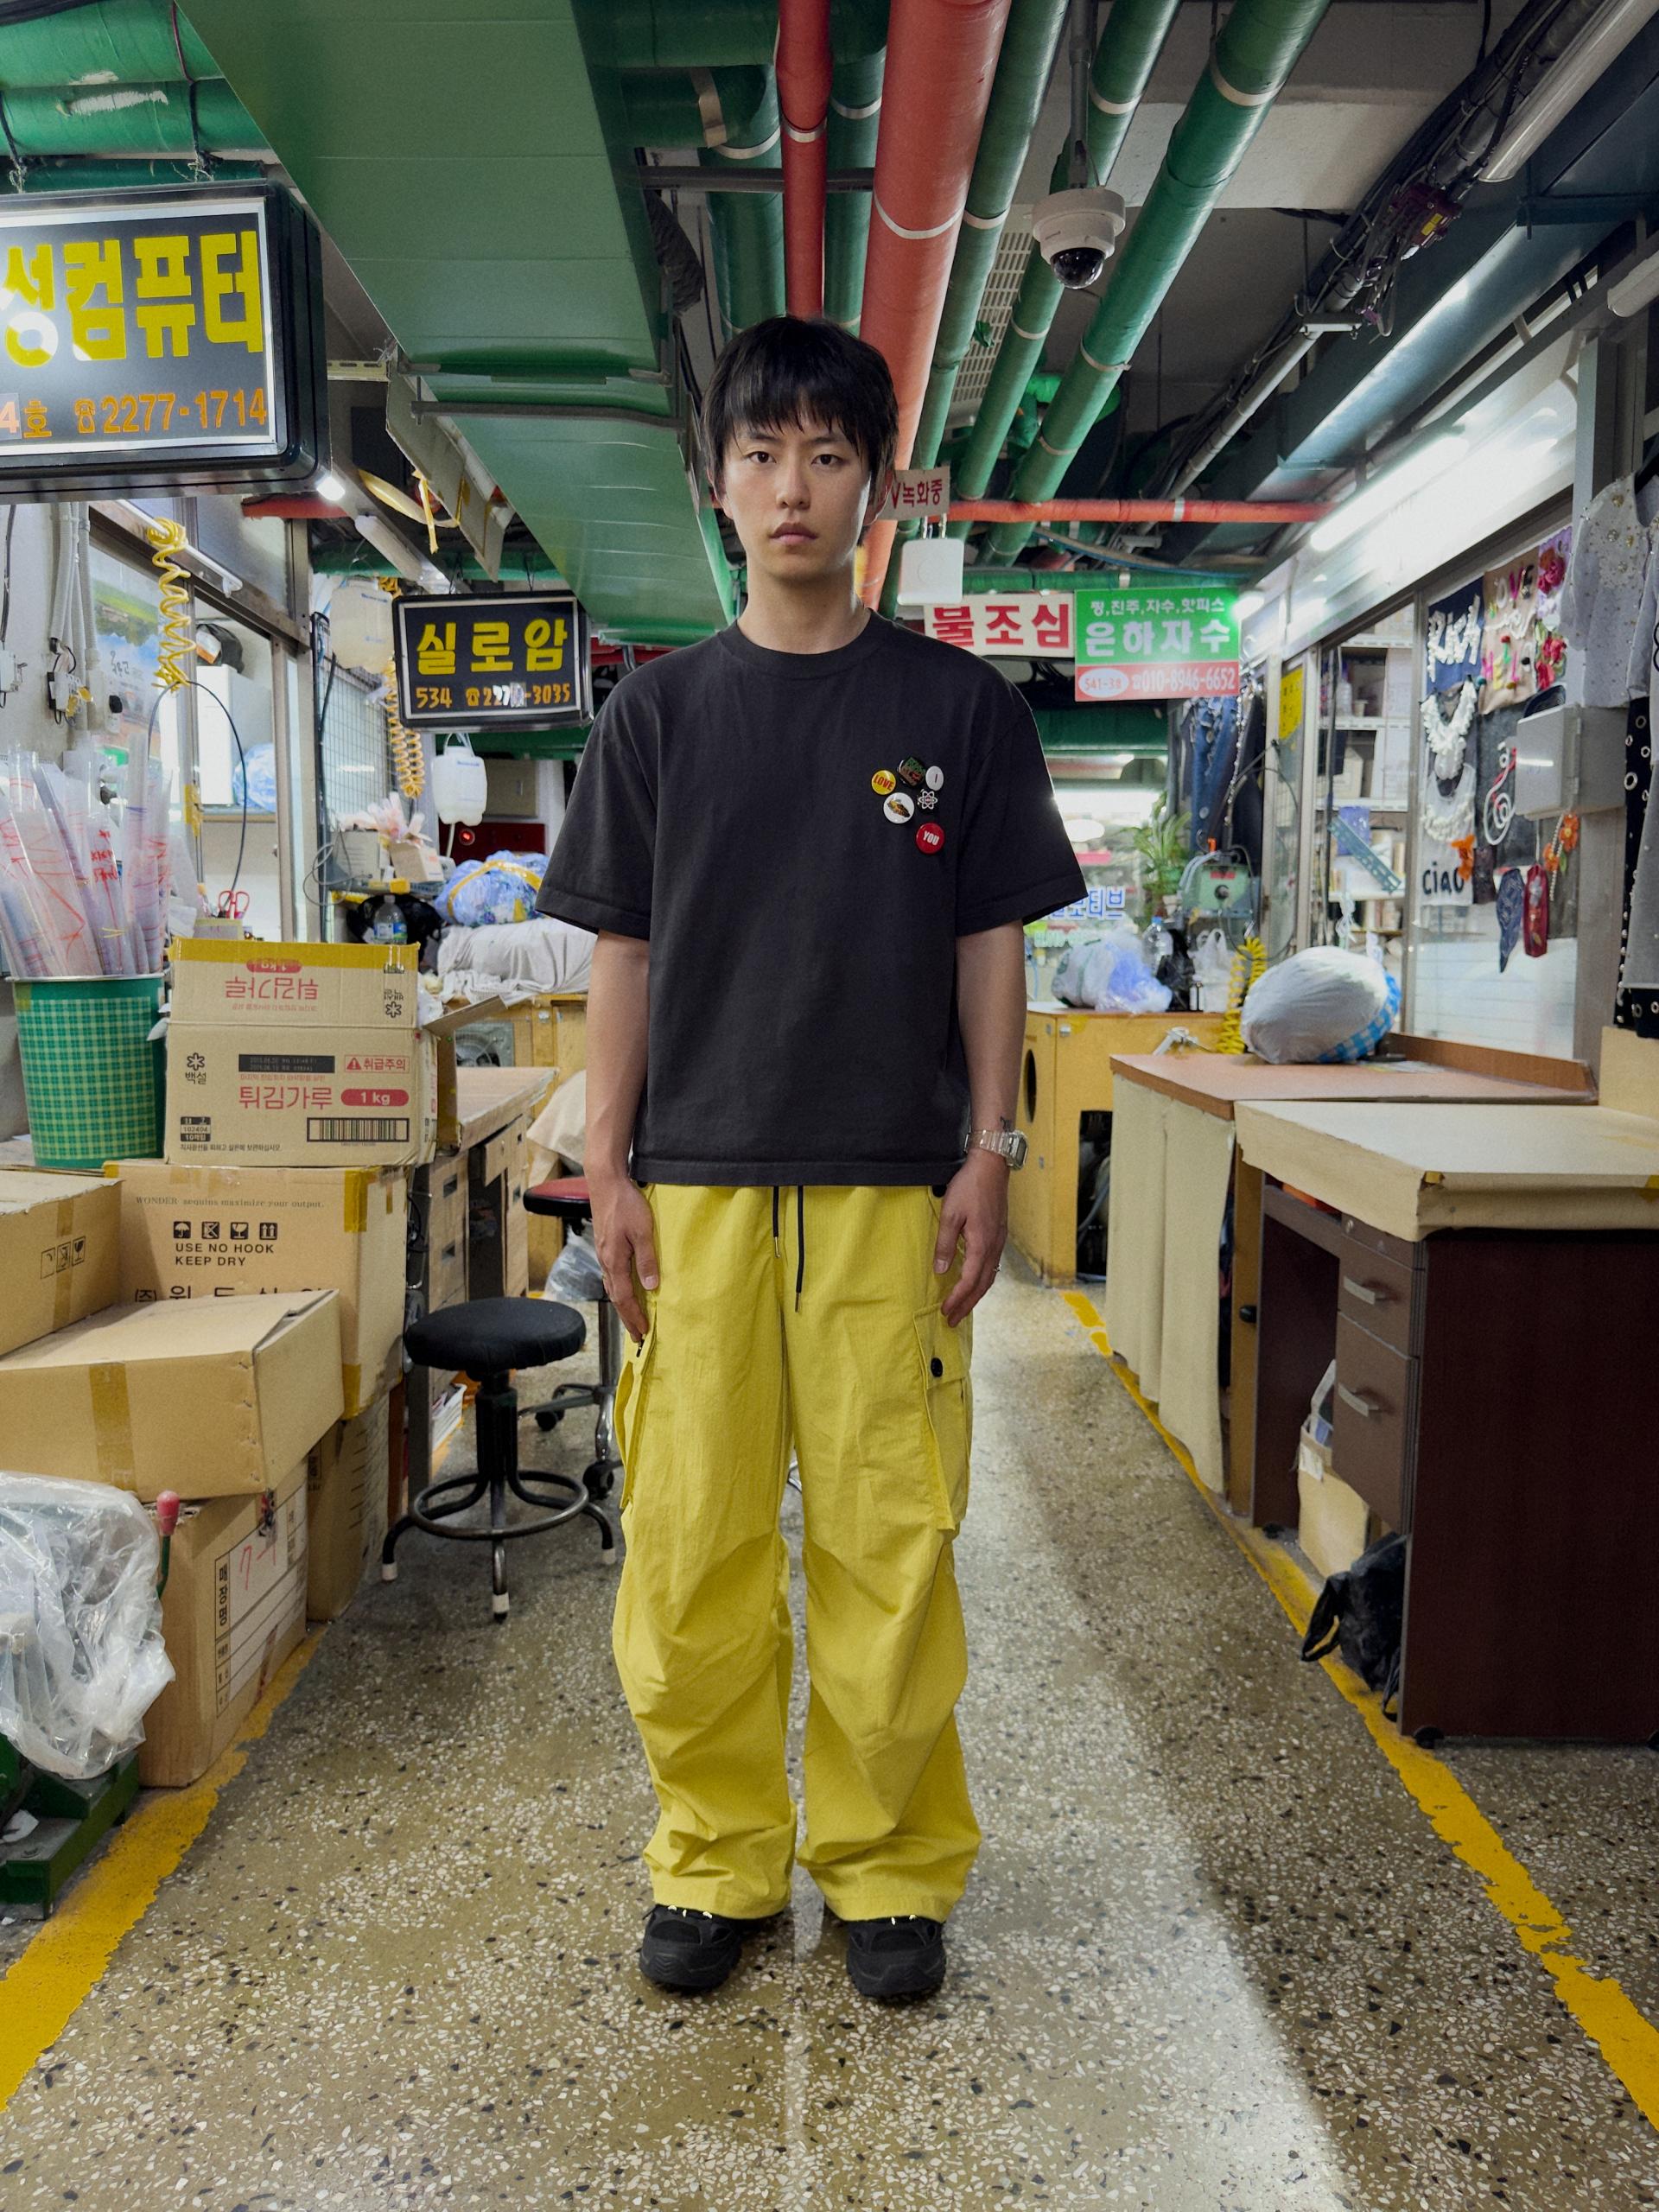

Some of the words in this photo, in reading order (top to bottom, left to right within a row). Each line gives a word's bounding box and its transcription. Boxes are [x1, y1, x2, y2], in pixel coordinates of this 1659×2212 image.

[2, 230, 264, 368] 성컴퓨터
[932, 603, 1070, 649] 불조심
[416, 618, 569, 676] 실로암
[1085, 619, 1231, 657] 은하자수
[416, 686, 453, 709] 534
[873, 773, 895, 791] LOVE
[923, 830, 940, 846] YOU
[225, 976, 319, 1001] 튀김가루
[363, 1057, 406, 1071] 취급주의
[185, 1071, 207, 1085] 백설
[238, 1085, 333, 1110] 튀김가루
[360, 1091, 367, 1104] 1
[372, 1091, 391, 1106] kg
[136, 1196, 178, 1205] WONDER
[268, 1200, 289, 1209] your
[175, 1243, 203, 1253] USE
[208, 1243, 228, 1253] NO
[234, 1243, 275, 1254] HOOK
[175, 1255, 212, 1266] KEEP
[217, 1256, 247, 1267] DRY
